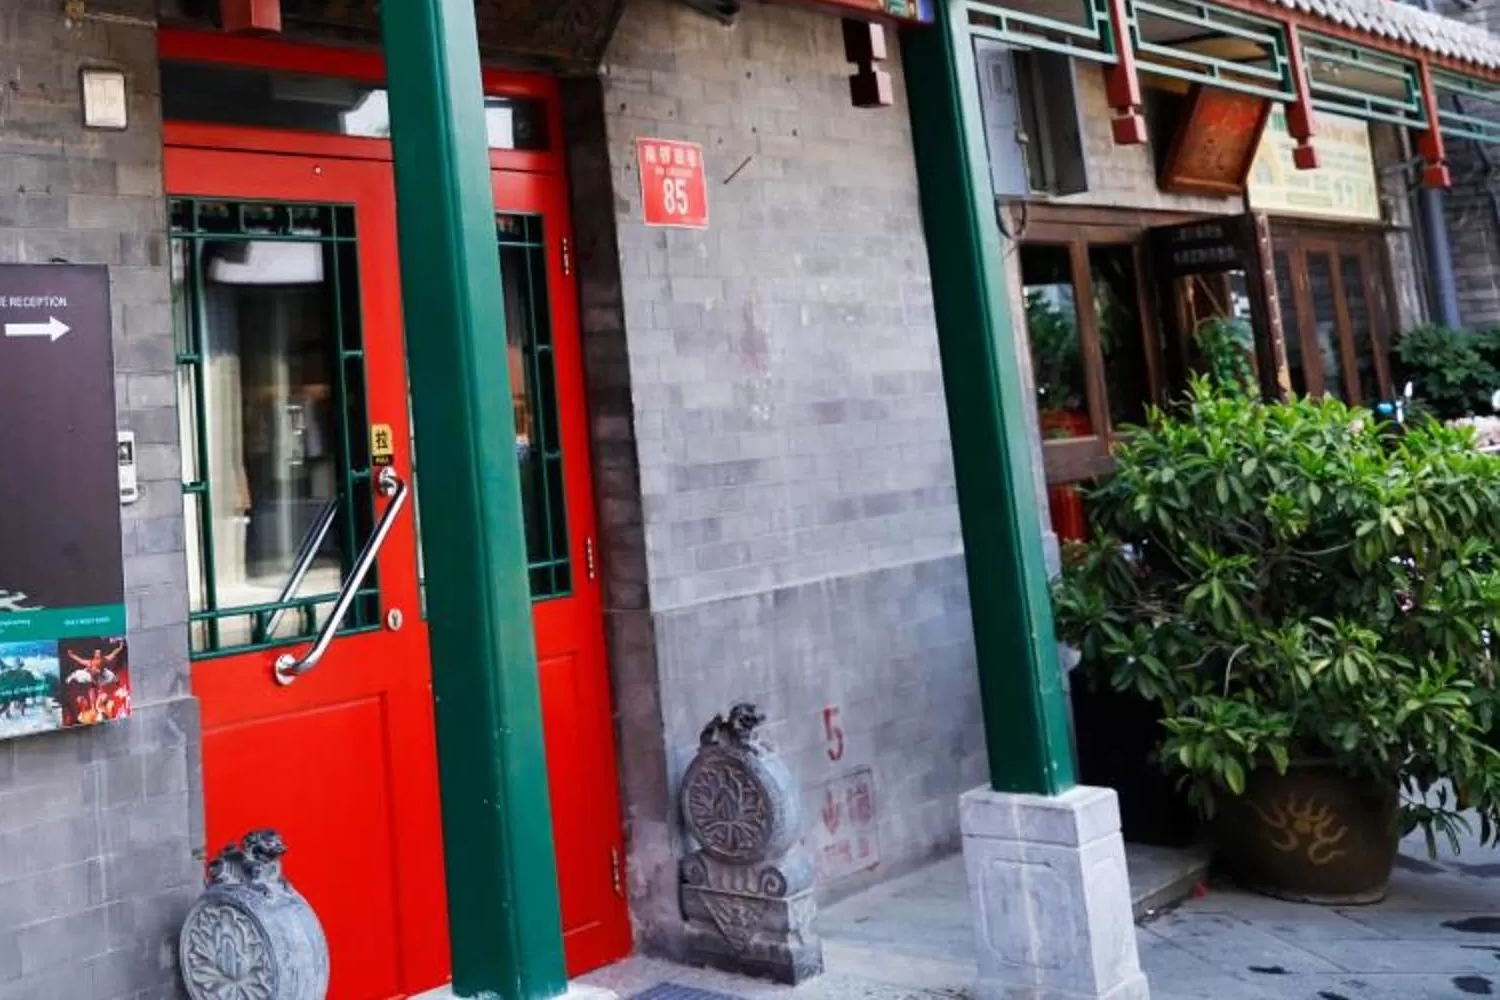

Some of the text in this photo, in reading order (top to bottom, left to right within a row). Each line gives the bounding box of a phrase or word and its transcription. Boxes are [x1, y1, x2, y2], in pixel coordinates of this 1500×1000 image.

[663, 178, 689, 215] 85
[9, 295, 67, 308] RECEPTION
[822, 702, 845, 761] 5
